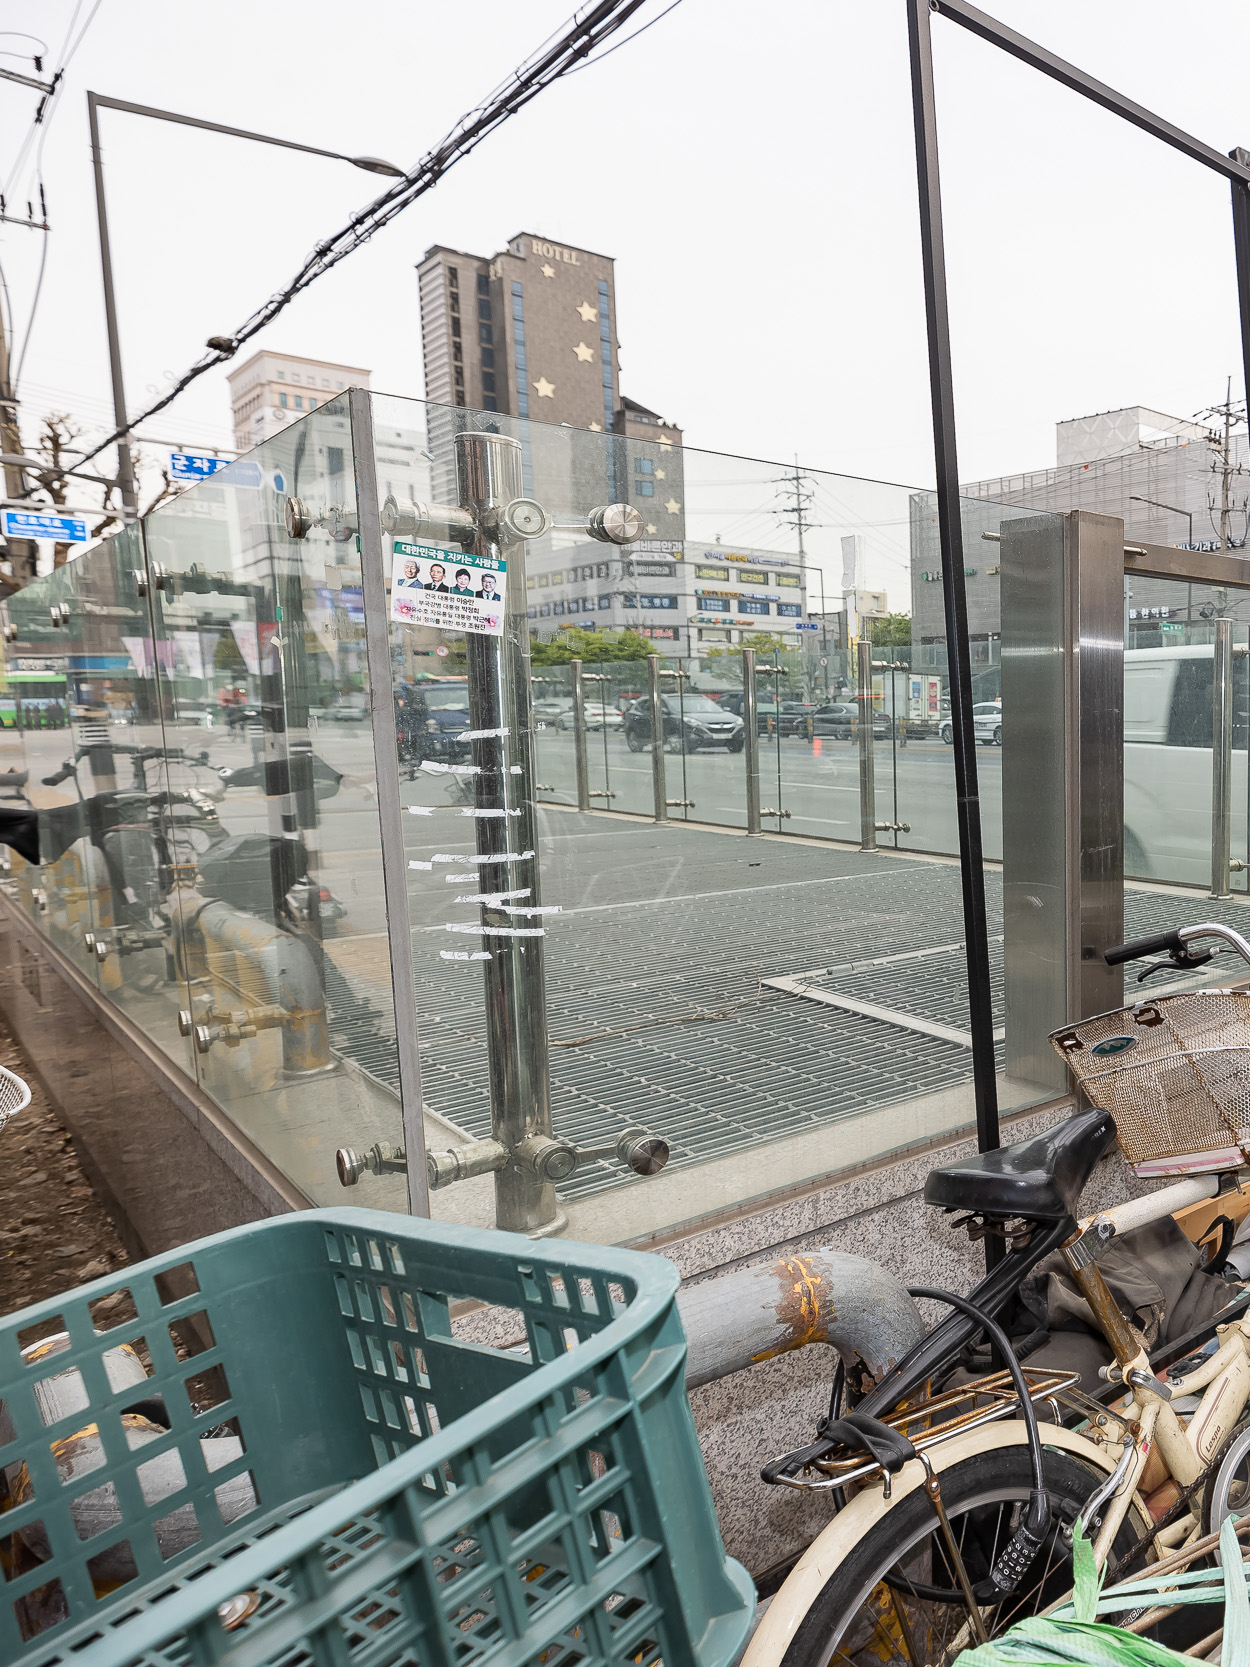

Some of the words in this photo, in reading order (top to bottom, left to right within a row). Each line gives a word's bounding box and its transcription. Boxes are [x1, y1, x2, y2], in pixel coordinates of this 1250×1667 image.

[531, 239, 581, 266] HOTEL
[401, 544, 446, 560] 대한민국을
[447, 553, 474, 564] 지키는
[474, 559, 500, 570] 사람들
[1141, 605, 1170, 619] 한의원
[1205, 1425, 1221, 1453] Lespo
